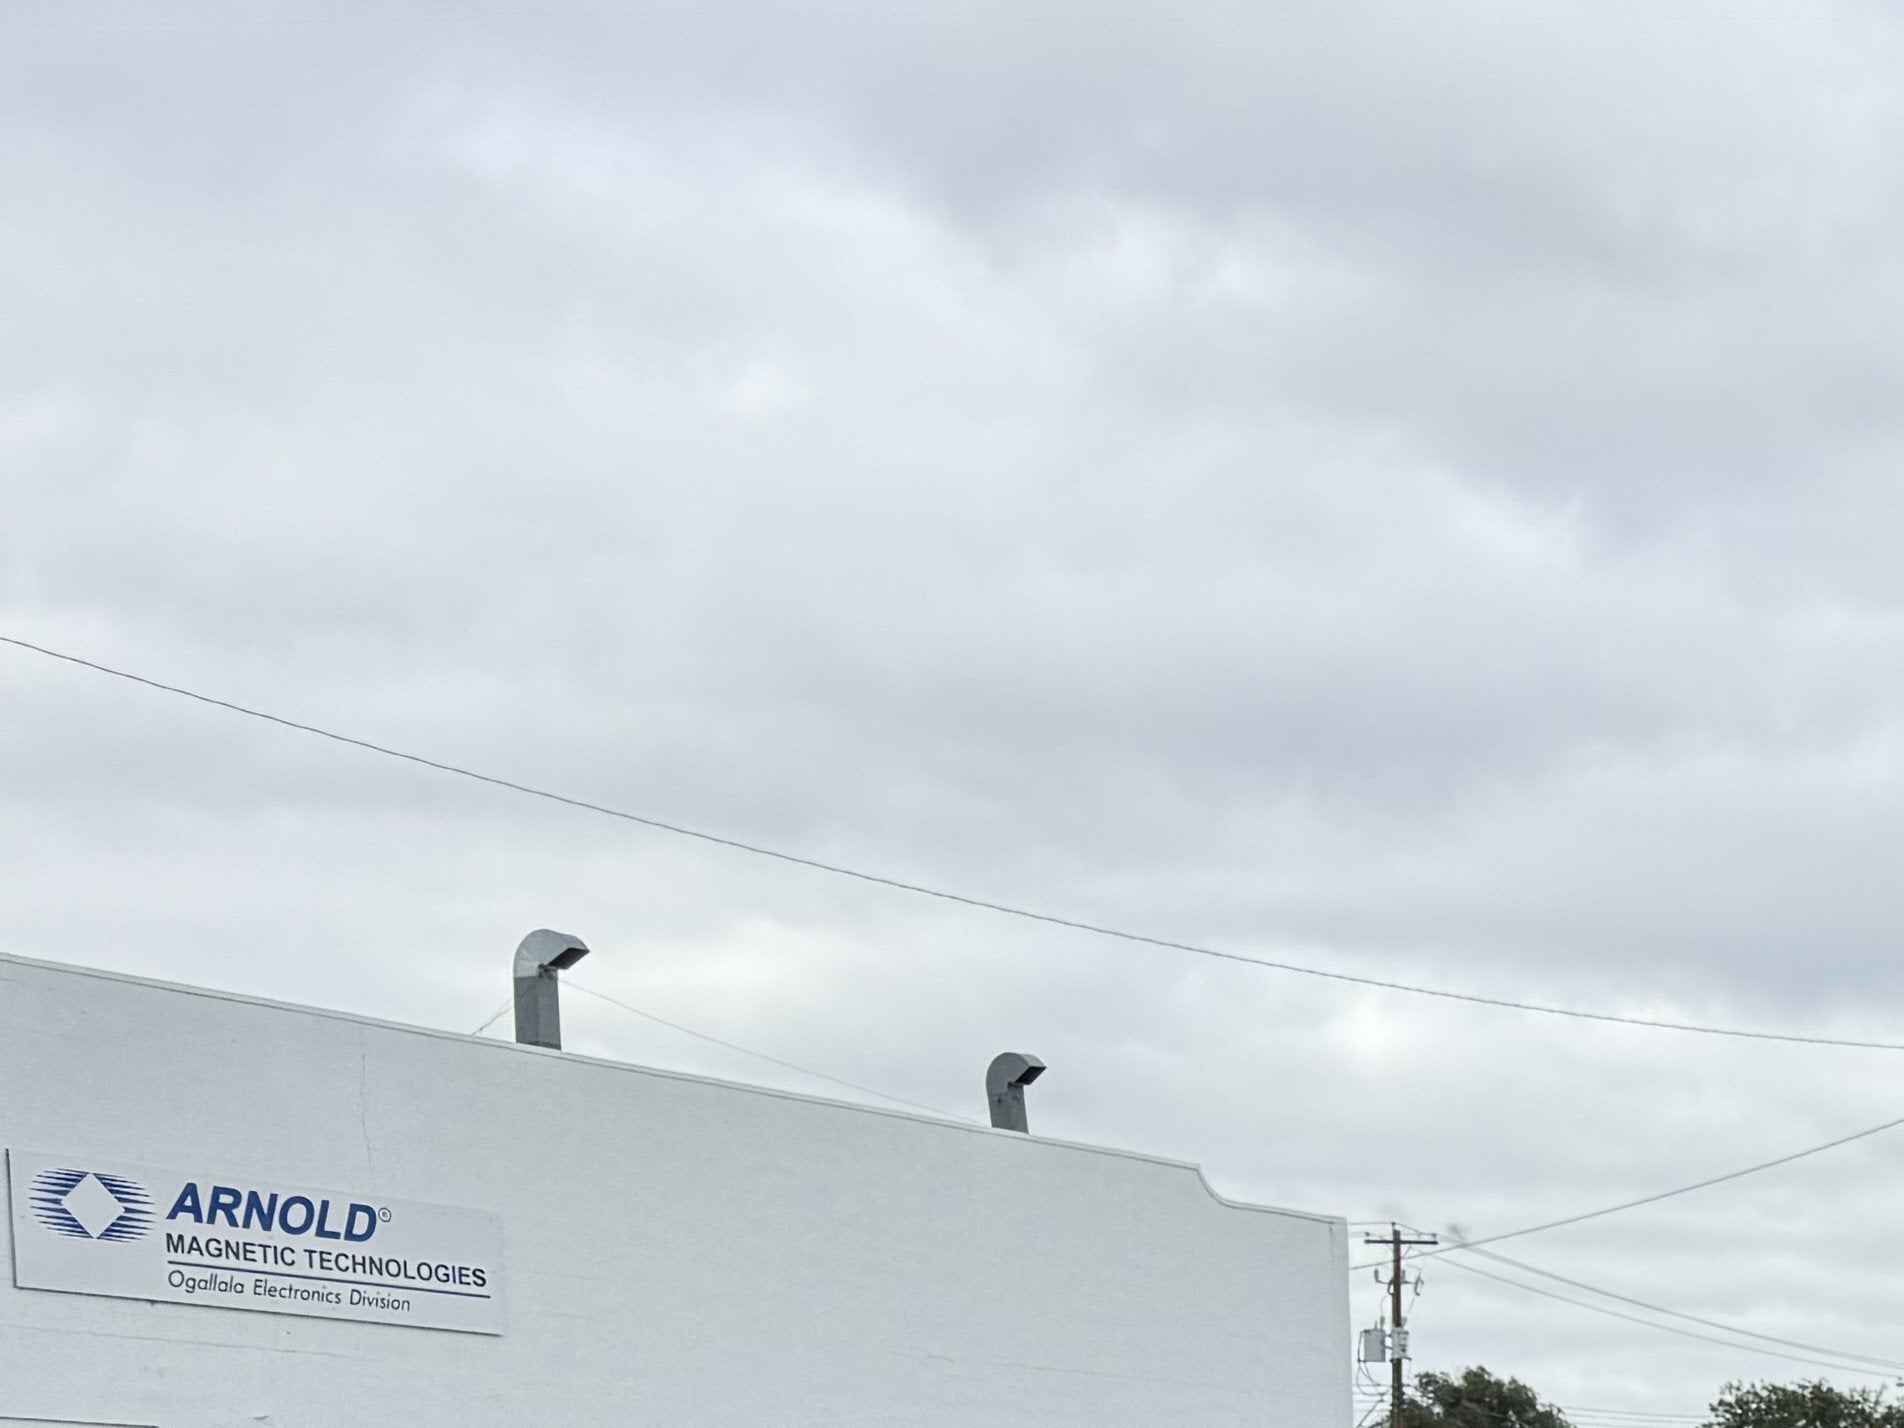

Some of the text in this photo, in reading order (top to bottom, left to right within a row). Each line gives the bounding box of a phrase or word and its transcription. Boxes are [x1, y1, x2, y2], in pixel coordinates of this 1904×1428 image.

[165, 1232, 487, 1288] MAGNETIC TECHNOLOGIES
[168, 1269, 411, 1312] Ogallala Electronics Division
